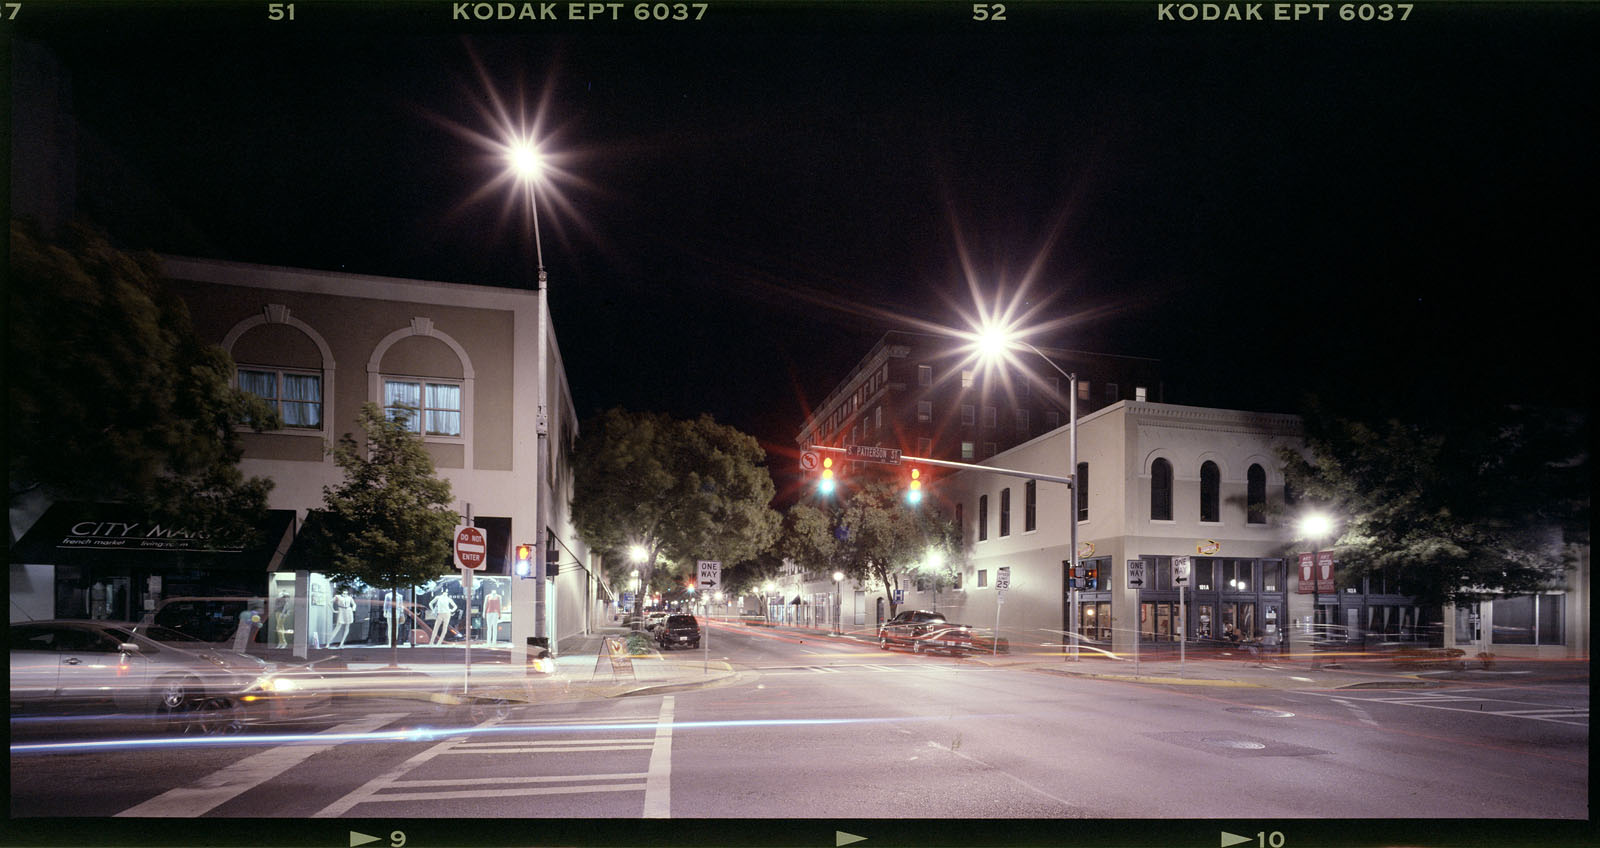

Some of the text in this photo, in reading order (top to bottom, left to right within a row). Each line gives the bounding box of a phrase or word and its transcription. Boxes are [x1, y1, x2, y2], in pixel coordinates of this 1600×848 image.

[268, 3, 294, 20] 51
[453, 3, 708, 20] KODAK EPT 6037
[972, 4, 1007, 20] 52
[1158, 4, 1413, 20] KODAK EPT 6037
[856, 447, 887, 458] PATTERSON
[71, 522, 139, 536] CITY
[461, 533, 482, 543] DO NOT
[462, 553, 480, 561] ENTER
[1174, 558, 1187, 567] ONE
[1130, 562, 1144, 570] ONE
[1174, 567, 1188, 575] WAY
[996, 580, 1009, 589] 25
[390, 830, 407, 848] 9
[1256, 830, 1285, 848] 10
